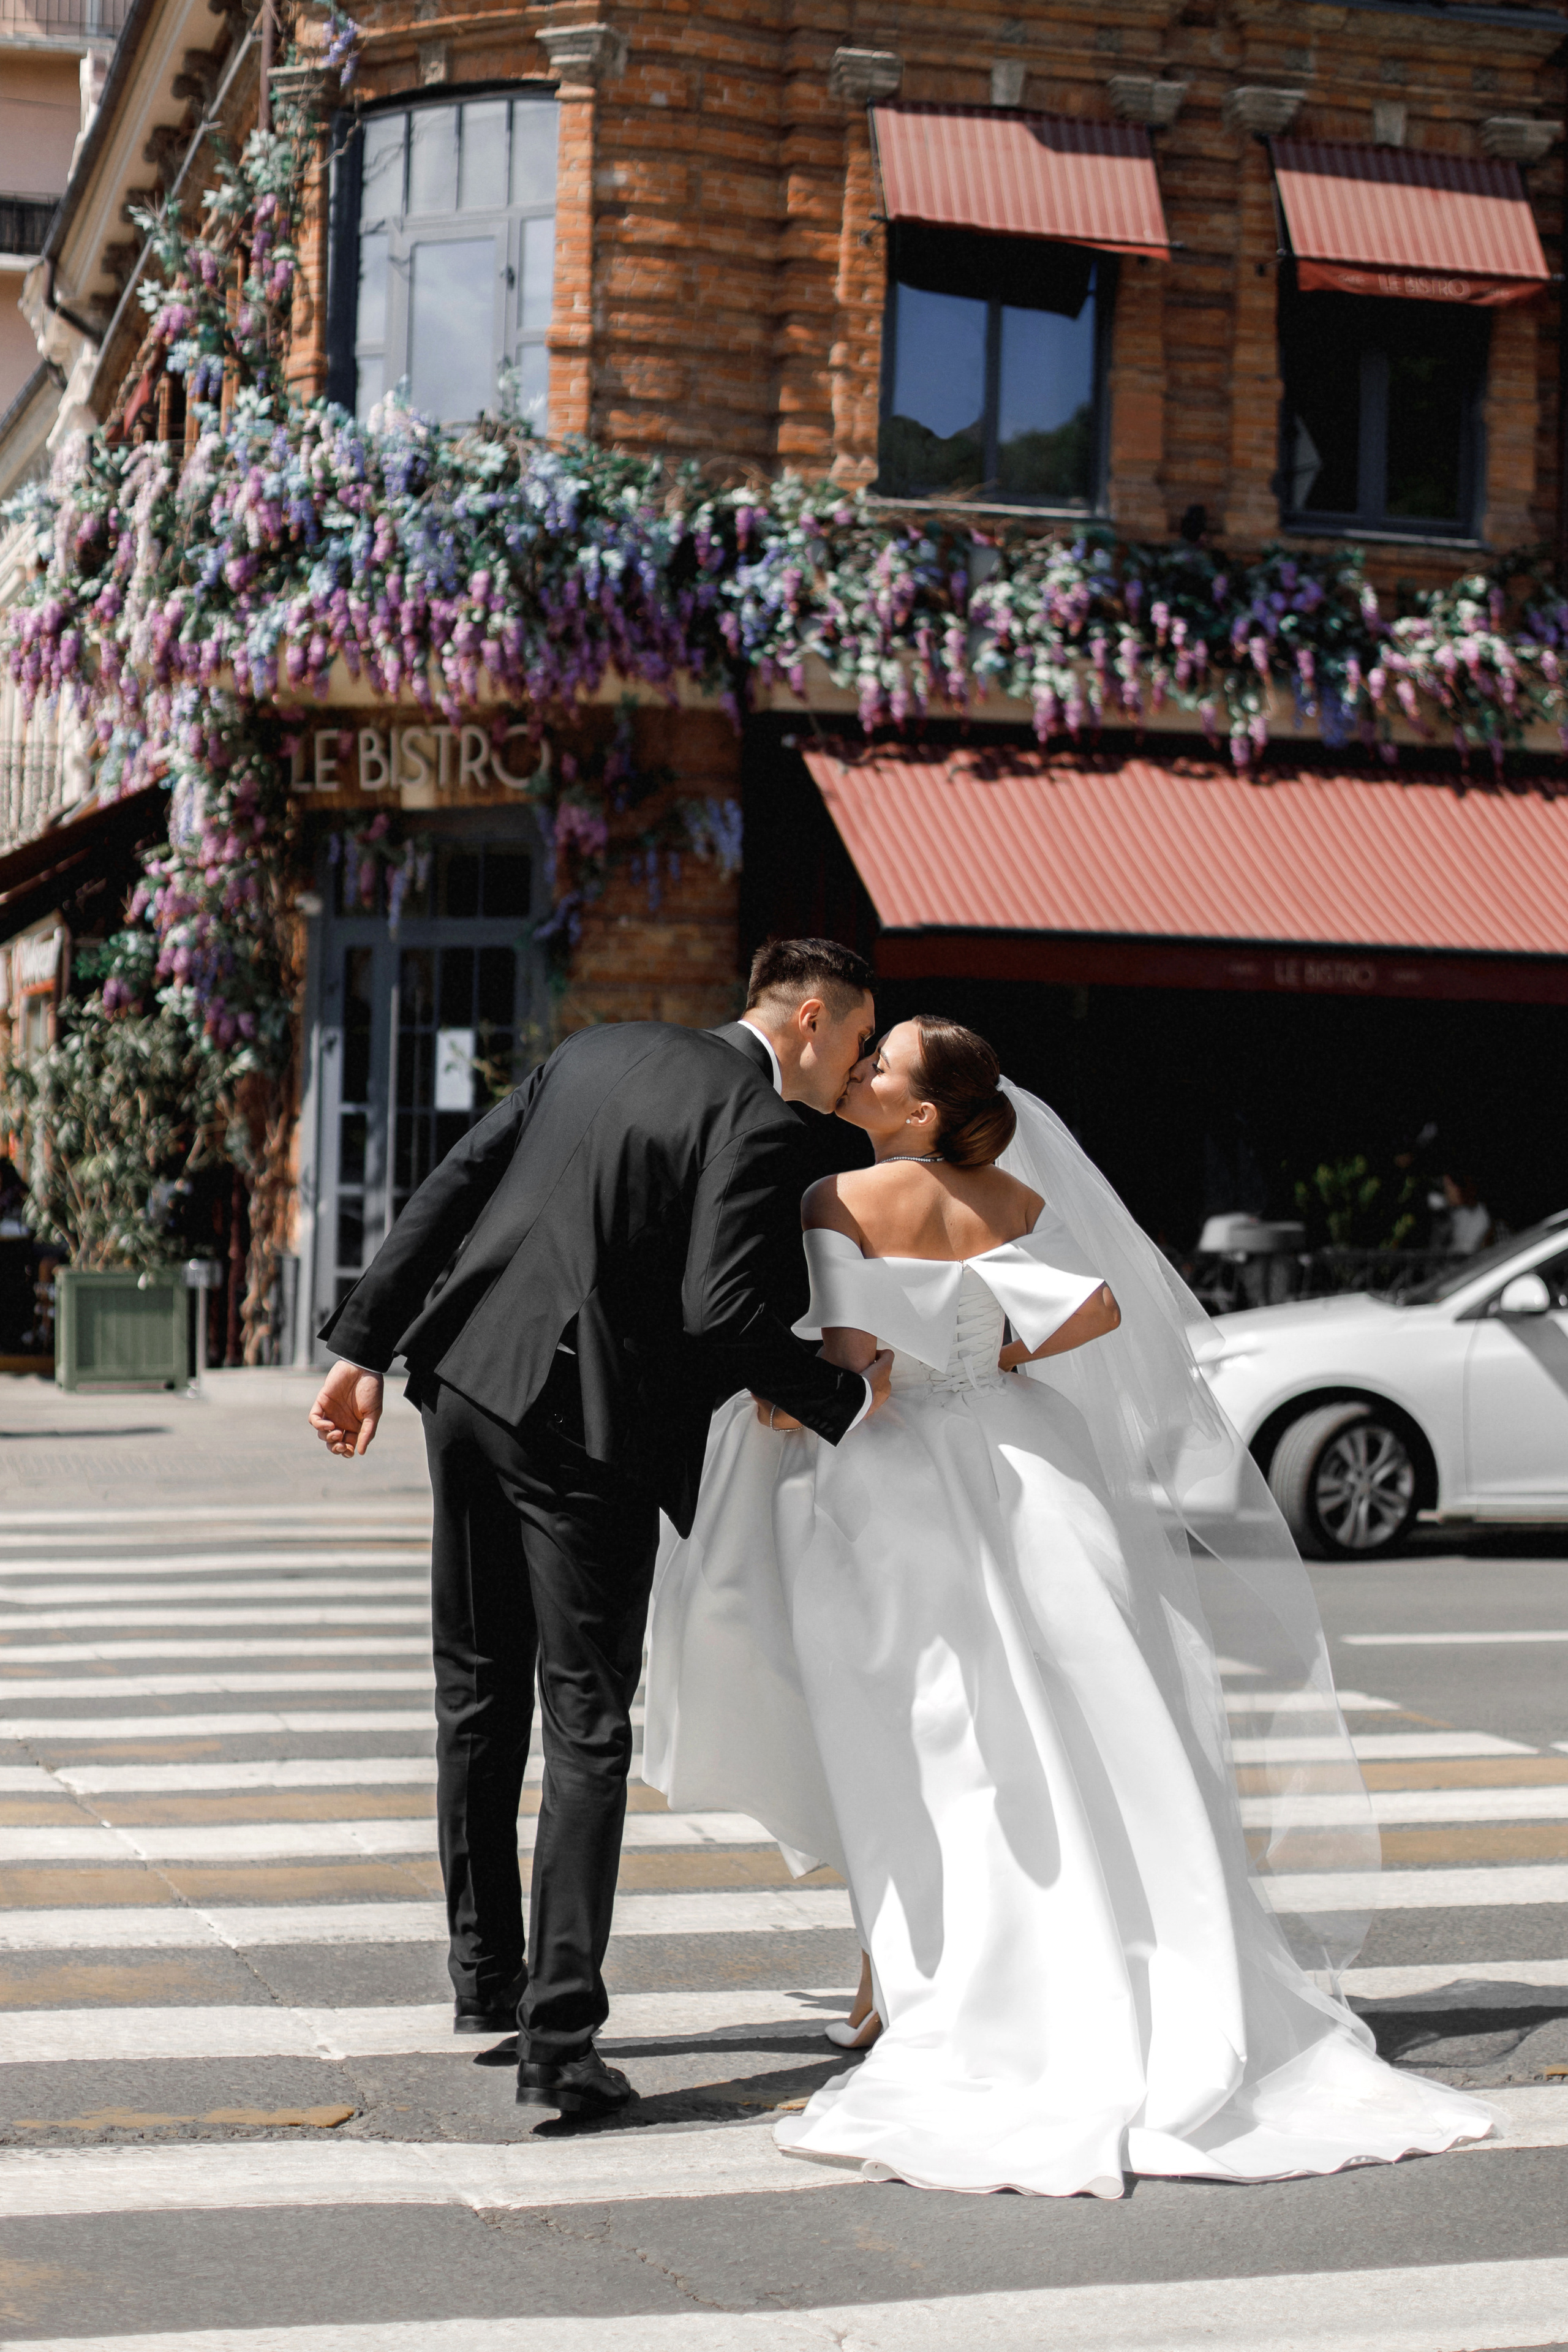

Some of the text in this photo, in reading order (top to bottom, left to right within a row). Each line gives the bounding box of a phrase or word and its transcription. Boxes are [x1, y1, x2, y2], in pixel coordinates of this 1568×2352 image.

[1379, 273, 1401, 294] LE
[1404, 274, 1470, 300] BISTRO
[290, 725, 550, 792] LE BISTRO
[1275, 960, 1299, 986] LE
